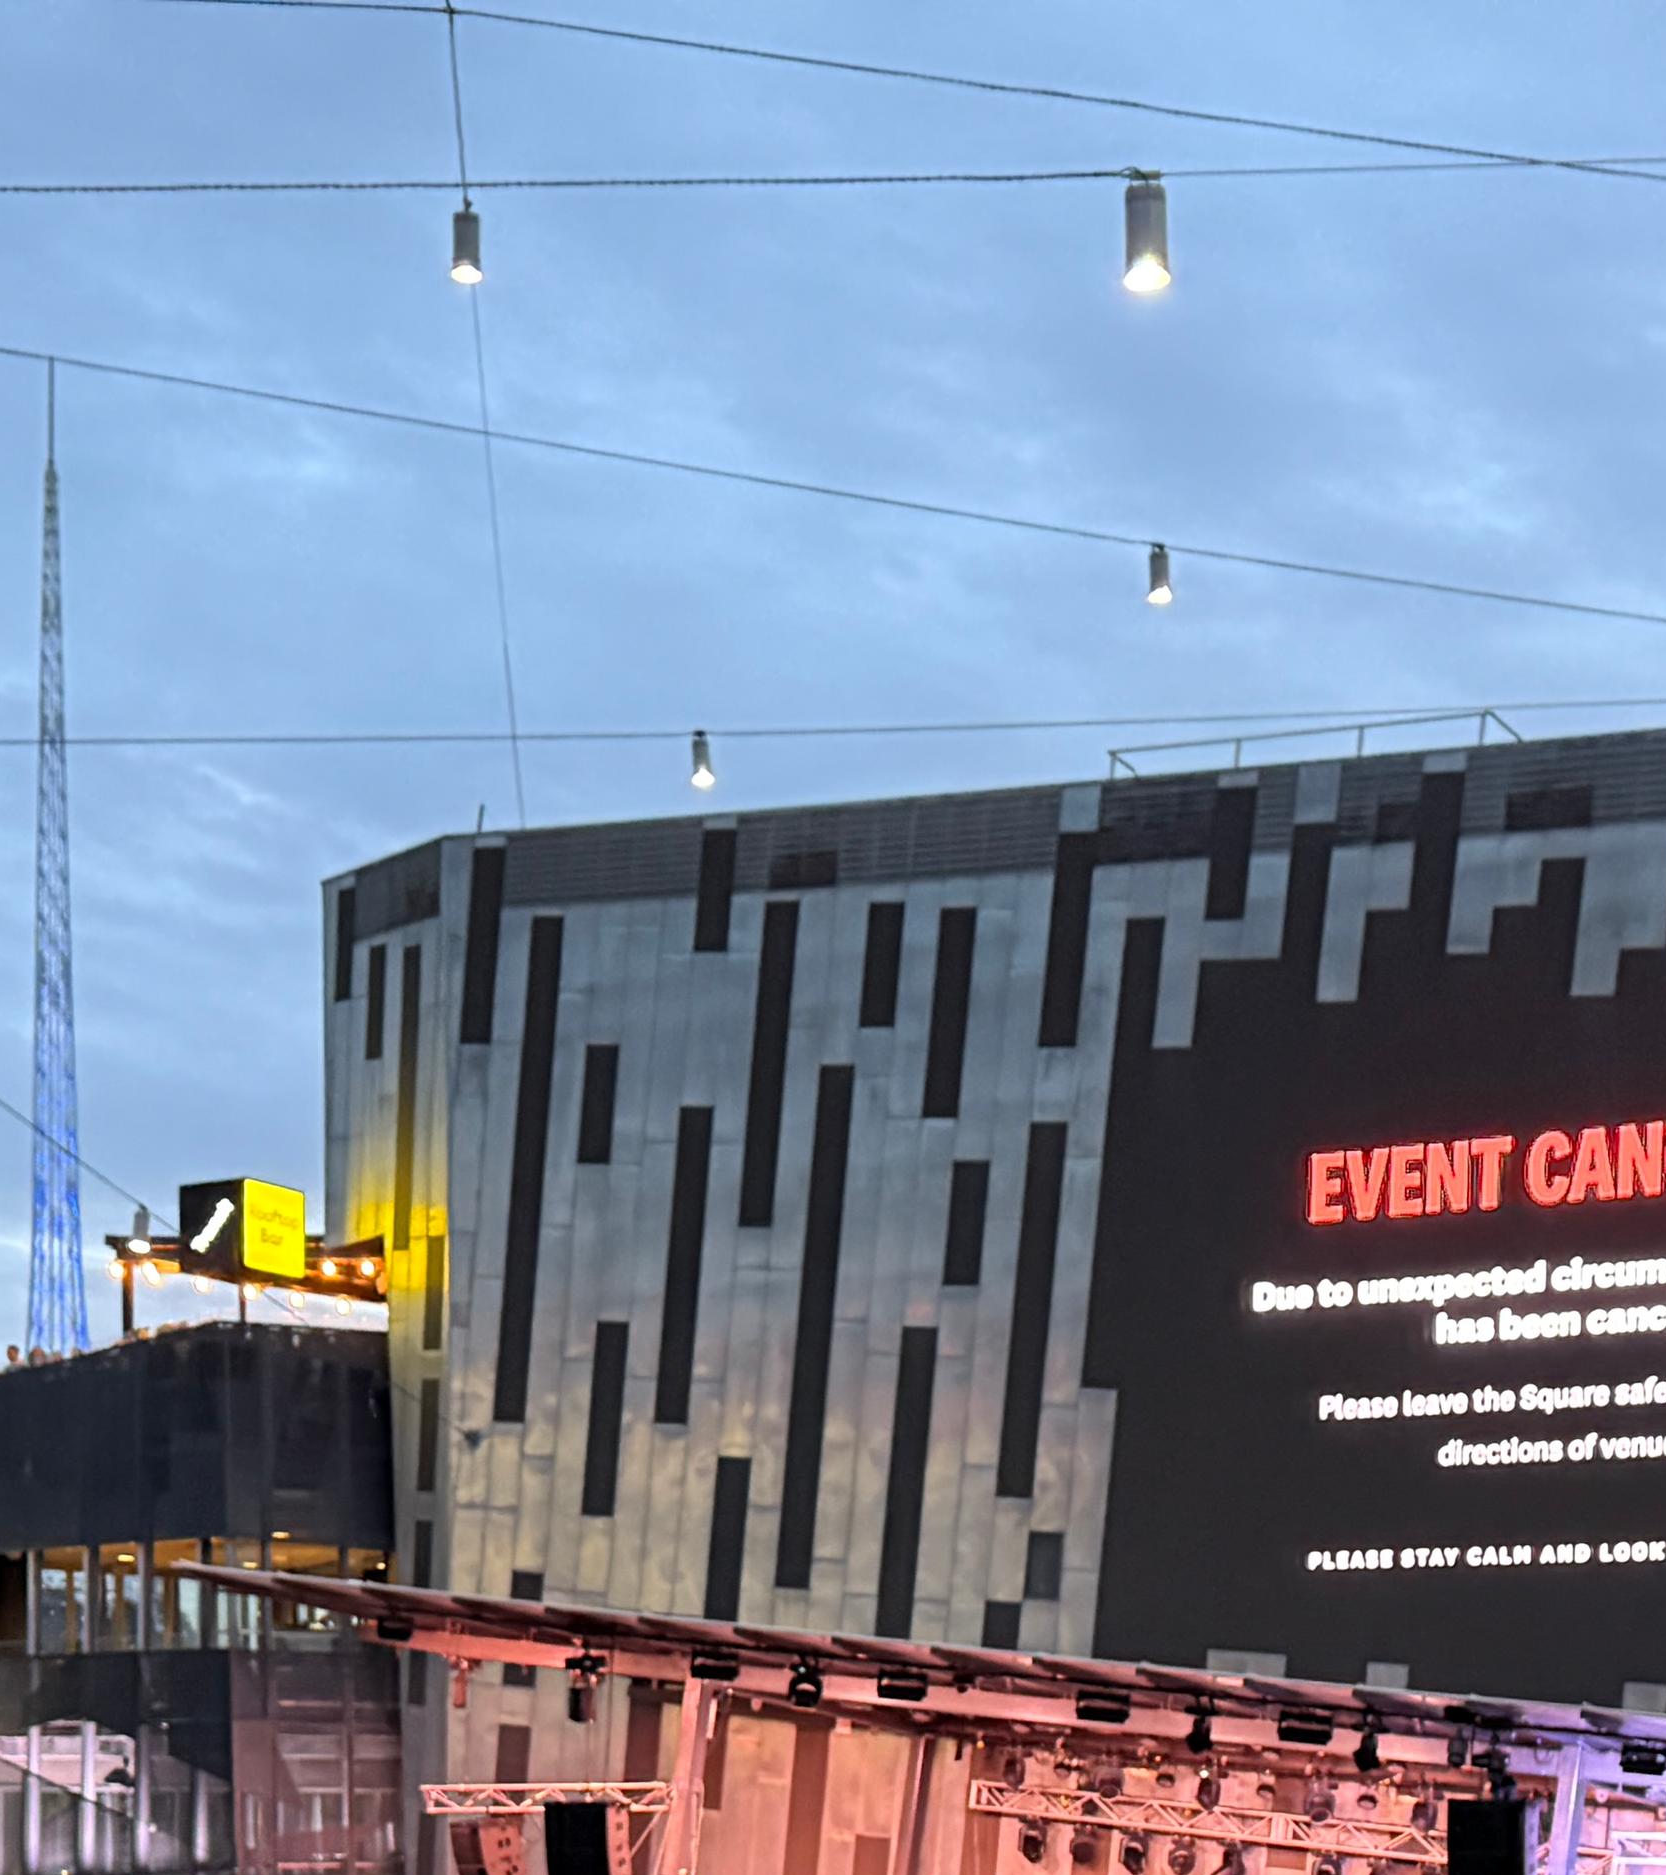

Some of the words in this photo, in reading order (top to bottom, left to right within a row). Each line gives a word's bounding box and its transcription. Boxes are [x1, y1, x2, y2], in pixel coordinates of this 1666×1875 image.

[1307, 1135, 1514, 1226] EVENT
[1252, 1281, 1314, 1312] Due
[1316, 1278, 1354, 1308] to
[1357, 1259, 1547, 1307] unexpected
[1435, 1311, 1495, 1344] has
[1498, 1307, 1582, 1341] been
[1318, 1393, 1399, 1420] Please
[1402, 1390, 1469, 1418] leave
[1472, 1384, 1516, 1413] the
[1519, 1383, 1611, 1415] Square
[1437, 1437, 1563, 1467] directions
[1567, 1431, 1598, 1461] of
[1307, 1548, 1394, 1571] PLEASE
[1400, 1547, 1460, 1568] STAY
[1466, 1545, 1532, 1567] CALM
[1539, 1543, 1592, 1565] AND
[1598, 1540, 1666, 1563] LOOK
